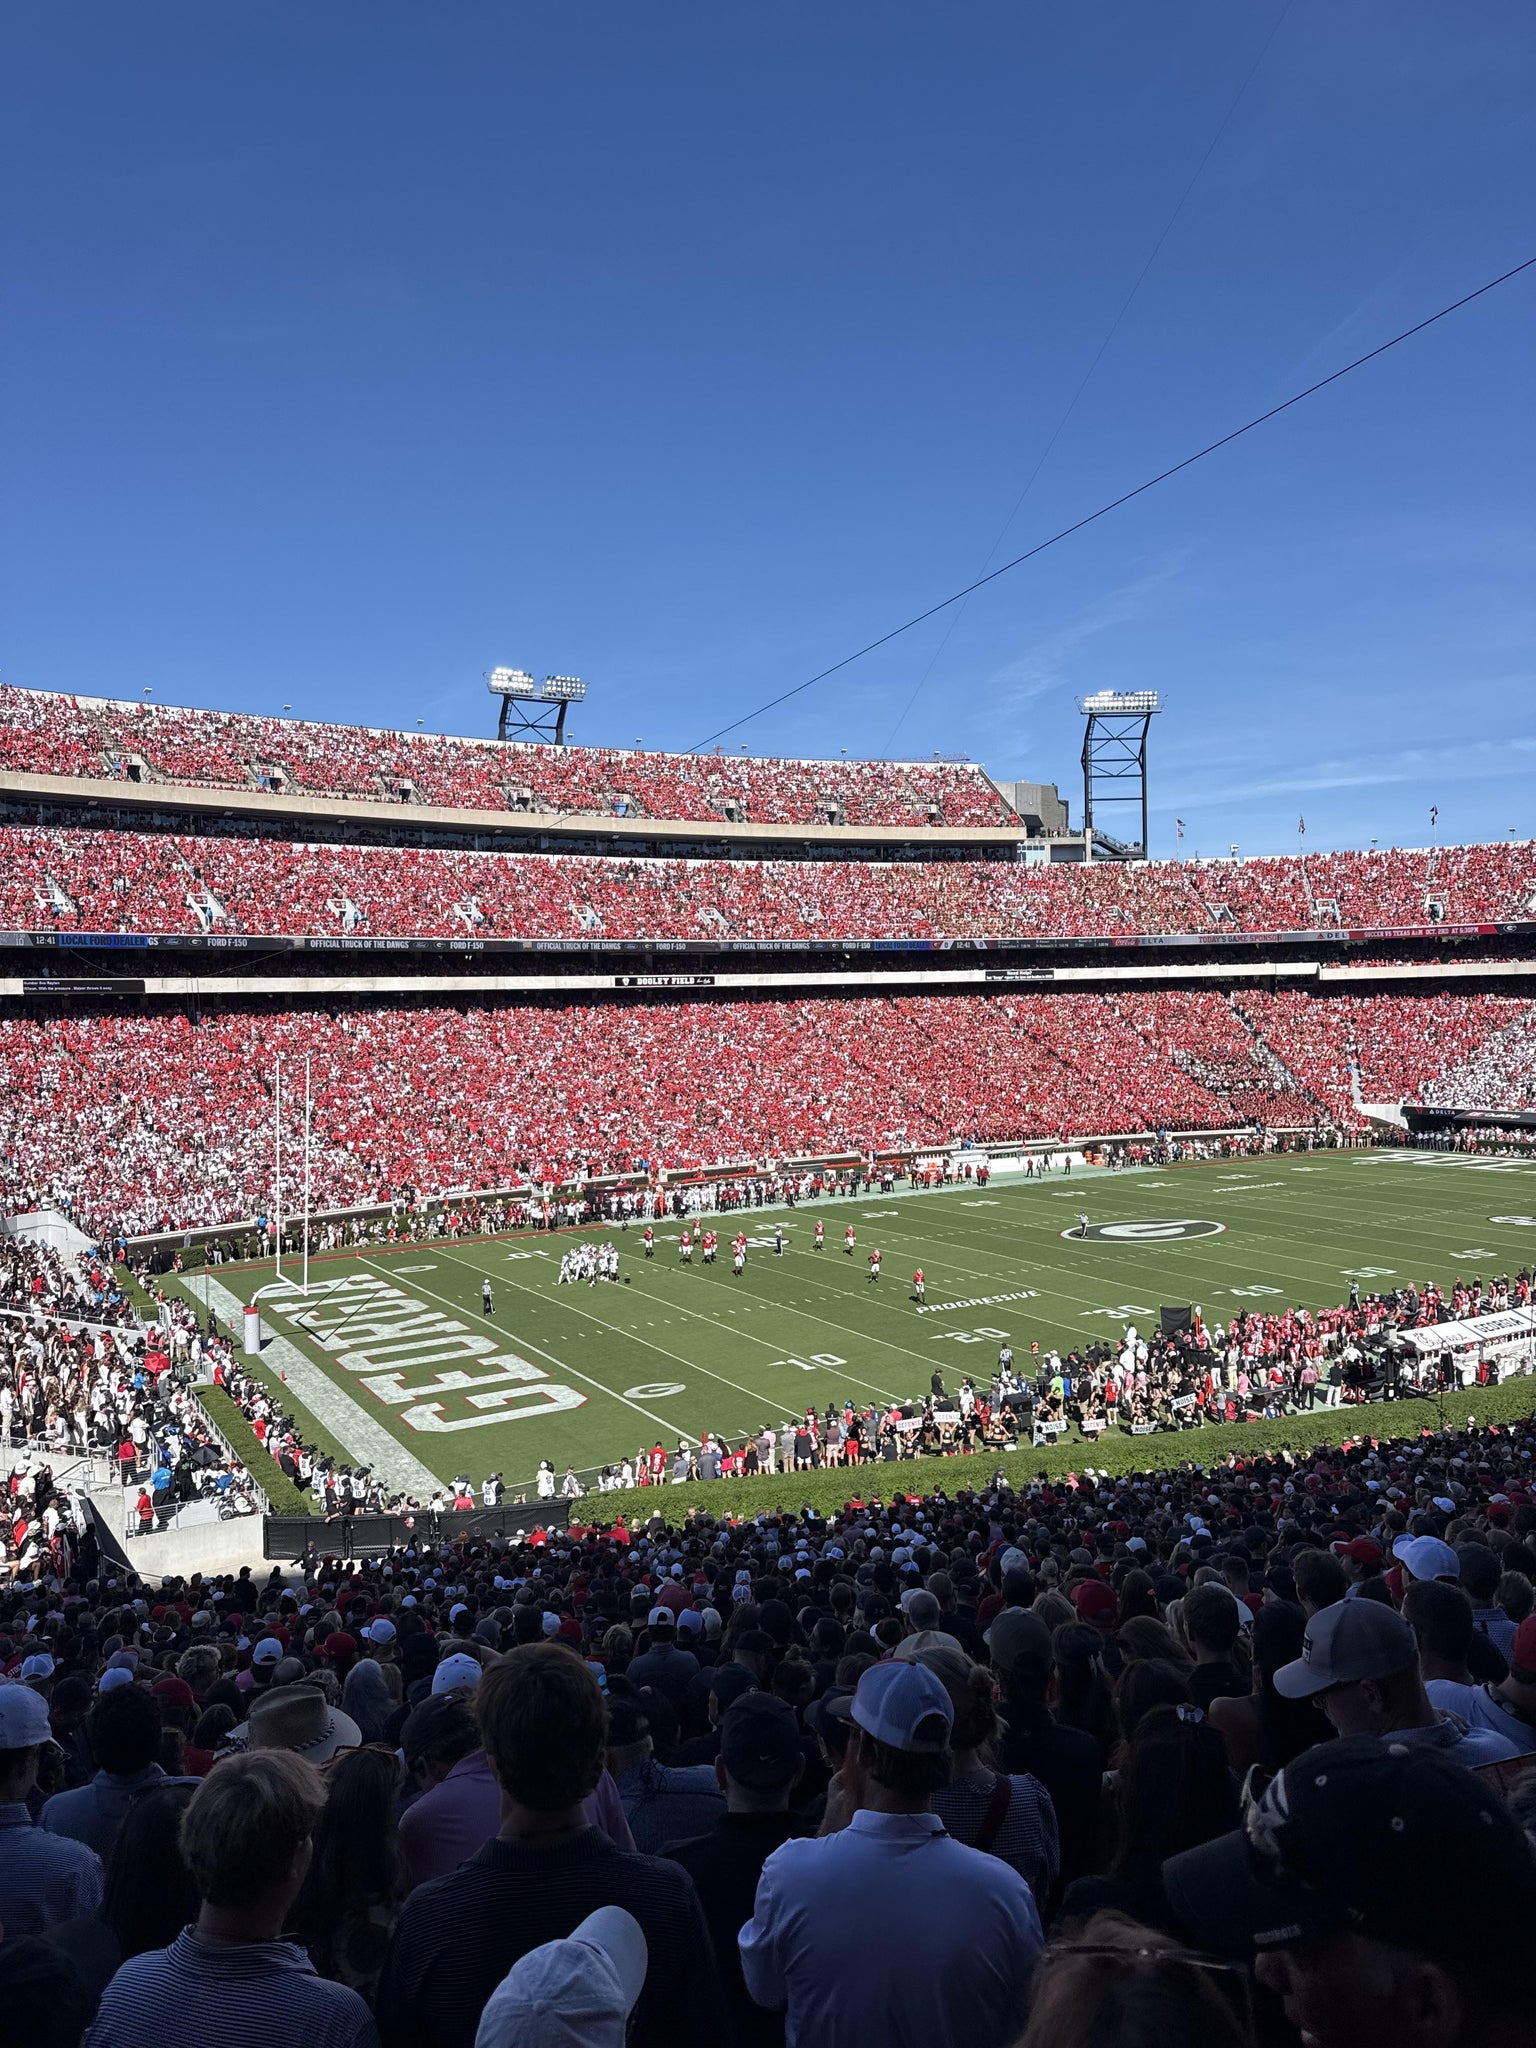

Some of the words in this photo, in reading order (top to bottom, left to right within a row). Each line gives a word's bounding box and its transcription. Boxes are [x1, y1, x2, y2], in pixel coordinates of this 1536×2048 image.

[15, 937, 25, 946] 10
[36, 936, 56, 945] 12:41
[61, 934, 88, 945] LOCAL
[90, 935, 112, 946] FORD
[113, 935, 145, 946] DEALER
[207, 938, 227, 947] FORD
[228, 938, 248, 947] F-150
[1228, 935, 1249, 943] GAME
[1249, 934, 1282, 942] SPONSOR
[310, 939, 340, 948] OFFICIAL
[341, 940, 362, 948] TRUCK
[364, 940, 372, 948] OF
[374, 940, 386, 949] THE
[386, 940, 409, 949] DAWGS
[450, 941, 467, 949] FORD
[467, 941, 485, 949] F-150
[536, 942, 562, 950] OFFICIAL
[733, 942, 756, 950] OFFICIAL
[756, 942, 773, 950] TRUCK
[774, 942, 780, 950] OF
[781, 942, 791, 950] THE
[956, 941, 971, 949] 12:41
[637, 977, 669, 985] DOOLEY
[671, 977, 695, 985] FIELD
[1339, 1266, 1398, 1278] 50
[1229, 1284, 1284, 1297] 40
[915, 1289, 1042, 1314] PROGRESSIVE
[1092, 1304, 1156, 1319] 30
[1473, 1317, 1525, 1333] GEORGIA
[944, 1327, 1011, 1344] 20
[1031, 1342, 1039, 1351] 2
[252, 1273, 591, 1434] GEORGIA
[786, 1353, 849, 1371] 10
[1175, 1396, 1194, 1406] NOISE
[897, 1419, 922, 1429] DEFENSE
[1044, 1422, 1063, 1431] NOISE
[1083, 1420, 1107, 1429] DEFENSE
[1134, 1425, 1153, 1433] NOISE
